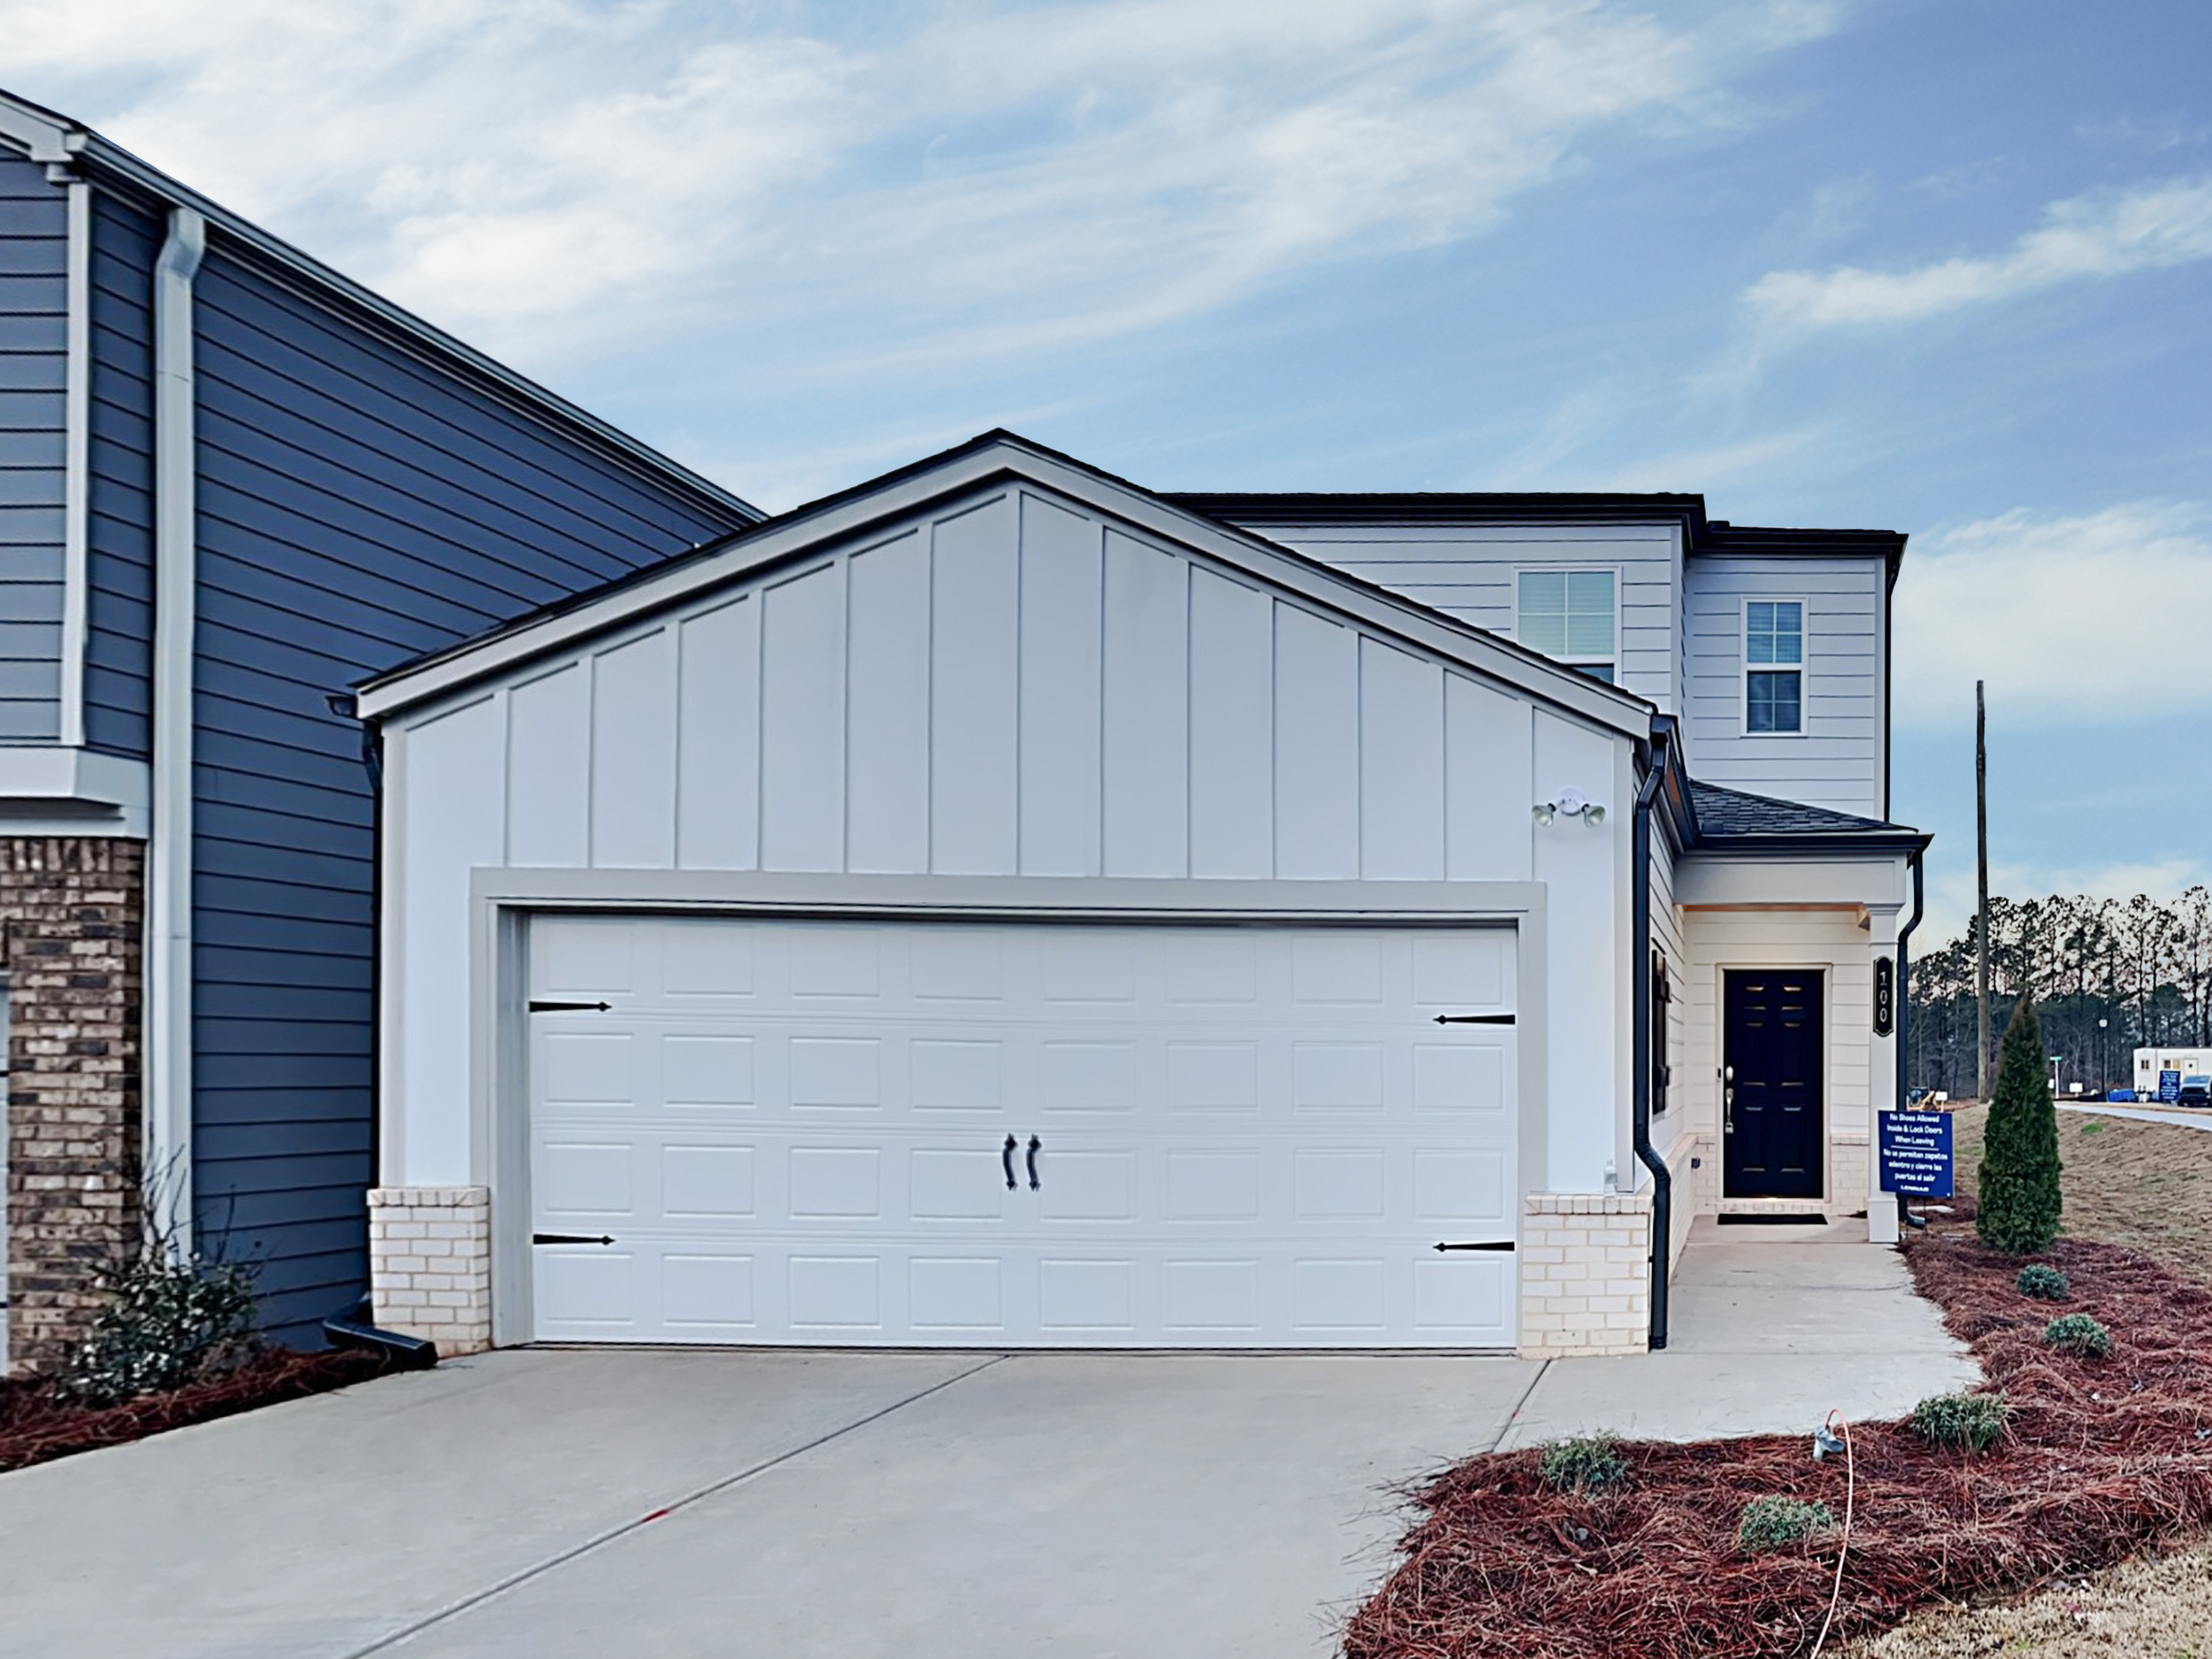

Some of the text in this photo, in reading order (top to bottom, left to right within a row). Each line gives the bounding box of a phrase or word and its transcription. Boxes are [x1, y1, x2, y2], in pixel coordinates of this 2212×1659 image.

[1879, 971, 1888, 1023] 100
[1890, 1113, 1940, 1123] No Shoes Allowed
[1903, 1124, 1908, 1133] &
[1910, 1125, 1924, 1133] Lock
[1924, 1125, 1943, 1134] Doors
[1912, 1136, 1935, 1147] Leaving
[1883, 1148, 1891, 1156] No
[1924, 1152, 1948, 1161] zapatos
[1916, 1163, 1933, 1171] cierre
